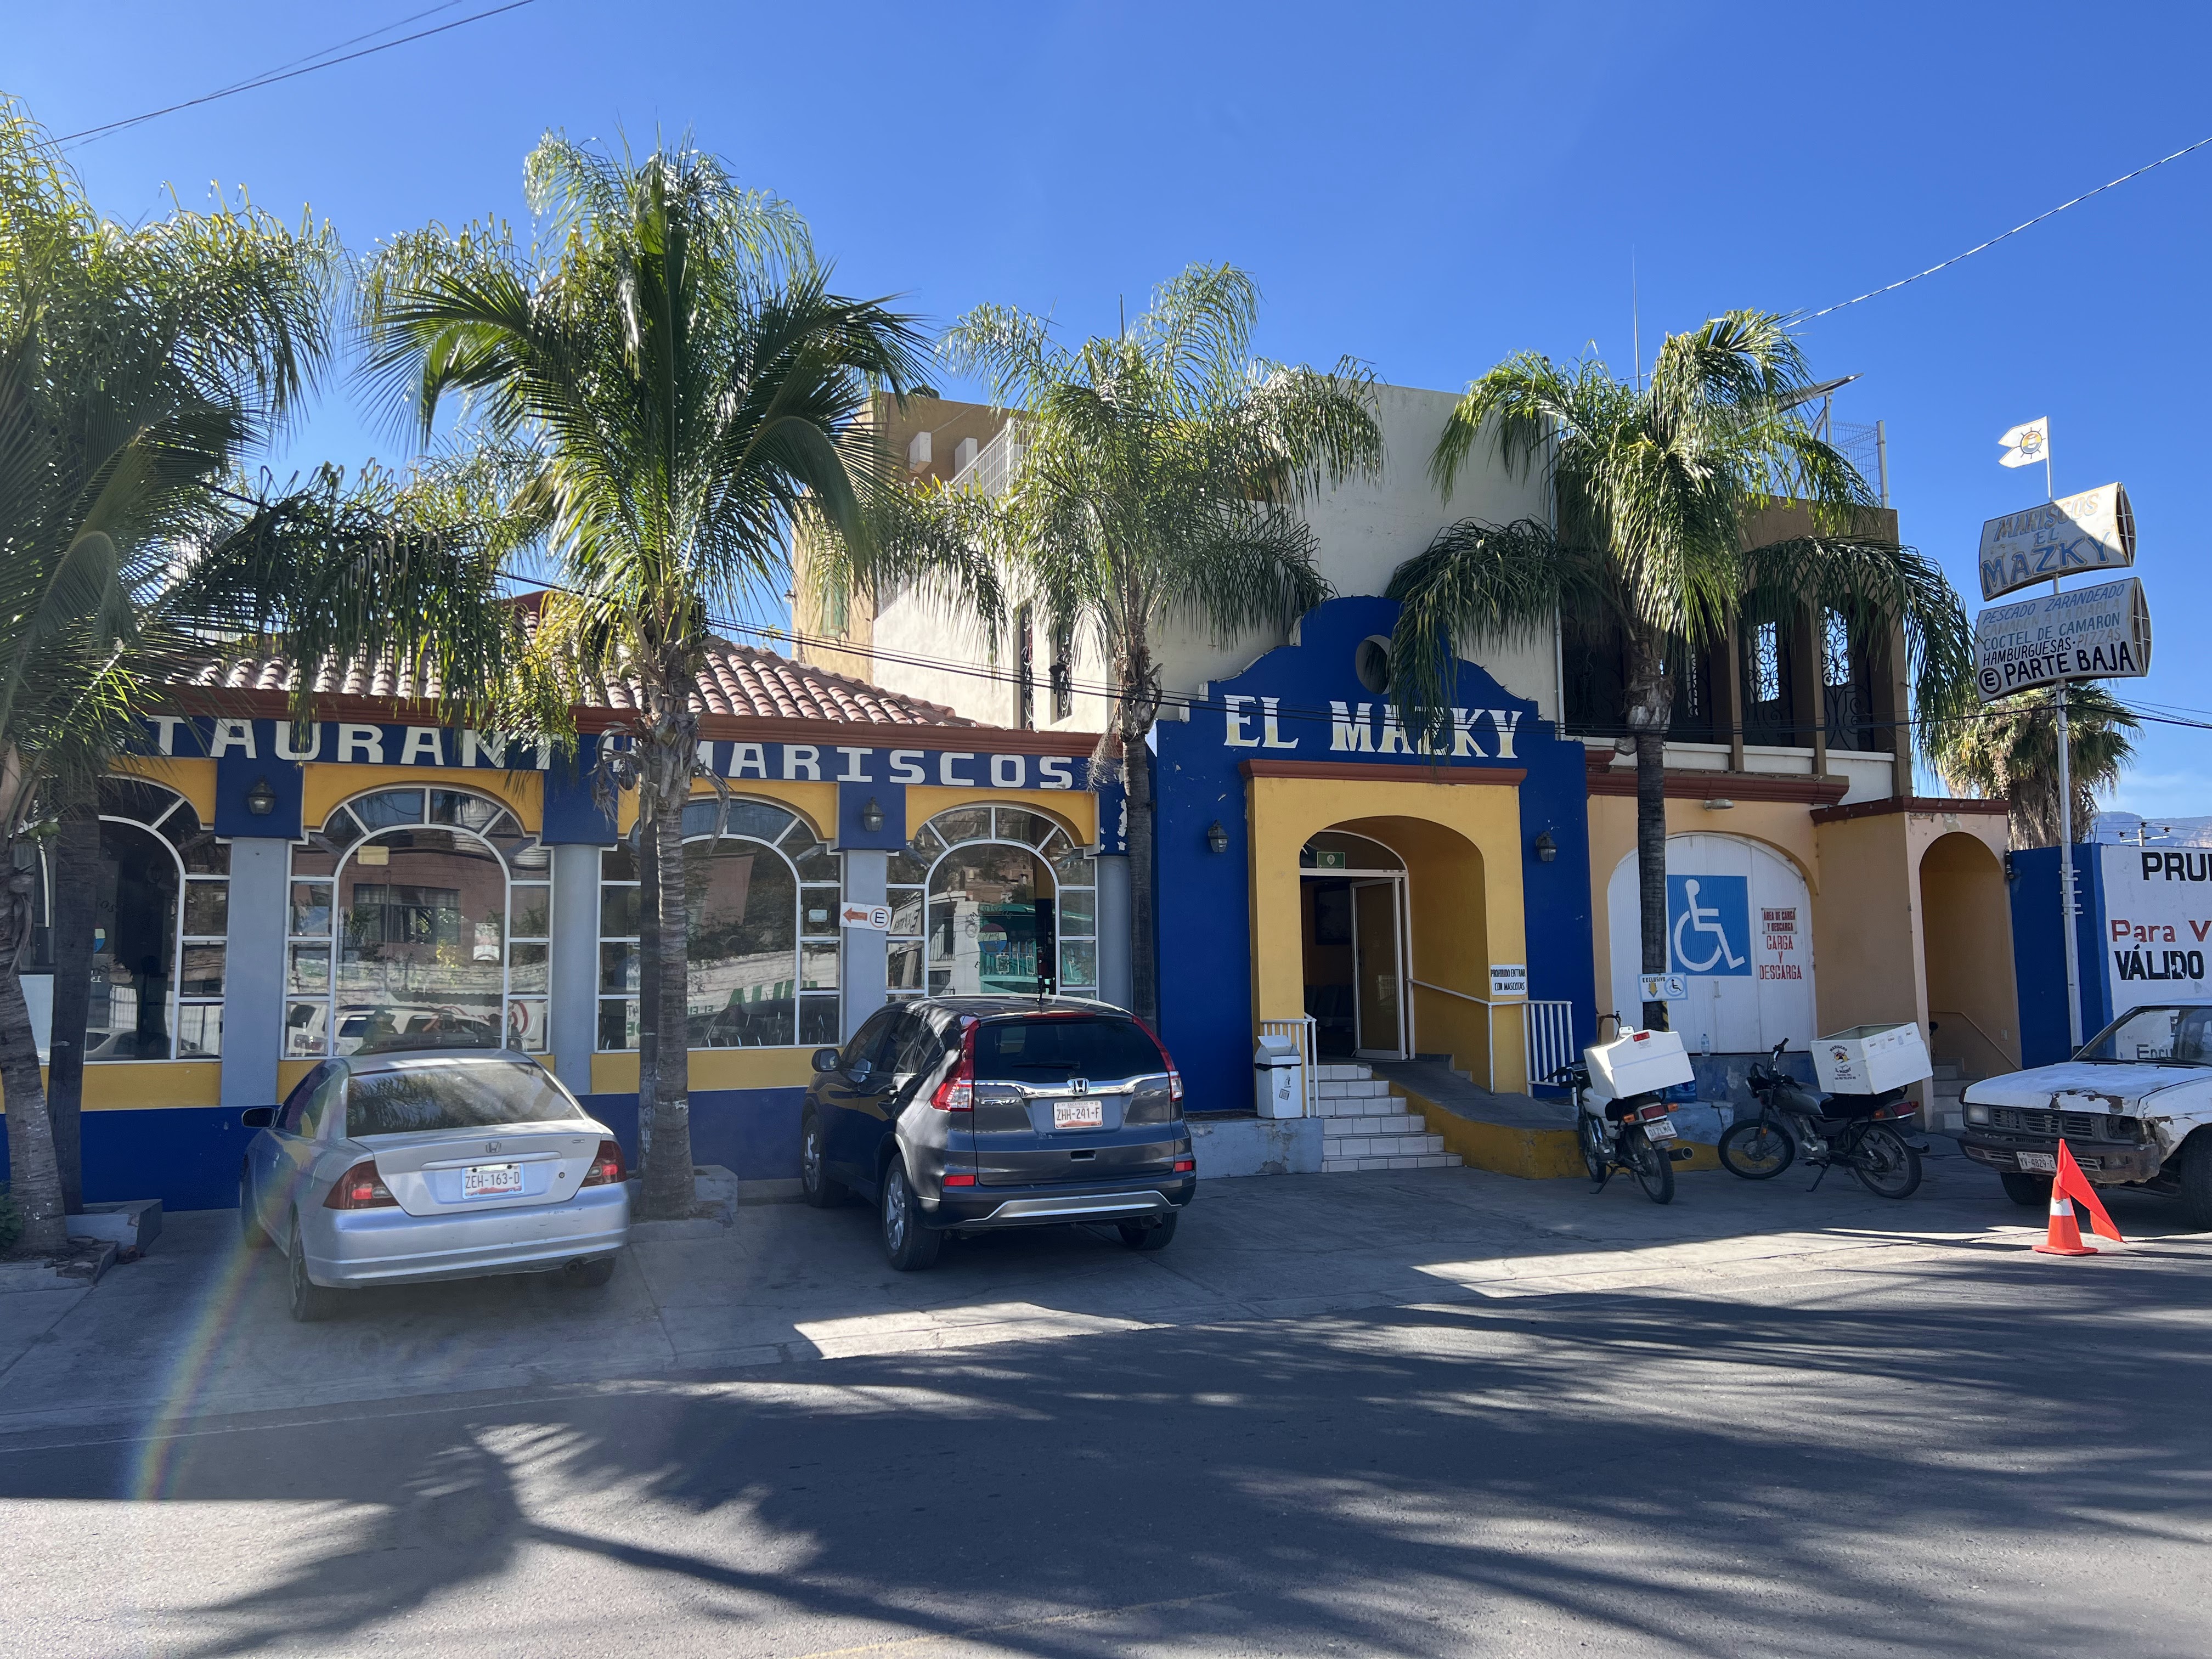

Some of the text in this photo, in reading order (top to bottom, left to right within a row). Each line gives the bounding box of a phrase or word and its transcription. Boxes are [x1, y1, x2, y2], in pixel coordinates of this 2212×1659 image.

[1994, 493, 2099, 542] MARISCOS
[2034, 528, 2059, 546] EL
[1981, 530, 2111, 596] MAZKY
[1983, 583, 2124, 624] PESCADO ZARANDEADO
[1983, 615, 2040, 637] CAMARON
[1983, 612, 2120, 651] COCTEL DE CAMARON
[2076, 627, 2121, 648] PIZZAS
[1984, 641, 2136, 686] E PARTE BAJA
[1223, 694, 1523, 759] EL MAZKY
[2141, 852, 2212, 881] PRU
[875, 912, 884, 923] E
[2111, 919, 2176, 942] Para
[1767, 935, 1793, 950] CARGA
[1778, 951, 1783, 963] Y
[2114, 944, 2204, 980] VÁLIDO
[1759, 965, 1802, 979] DESCARGA
[1504, 982, 1525, 990] MASCOTAS
[1057, 1107, 1099, 1121] ZHH-241-F
[466, 1171, 520, 1189] ZEH-163-D
